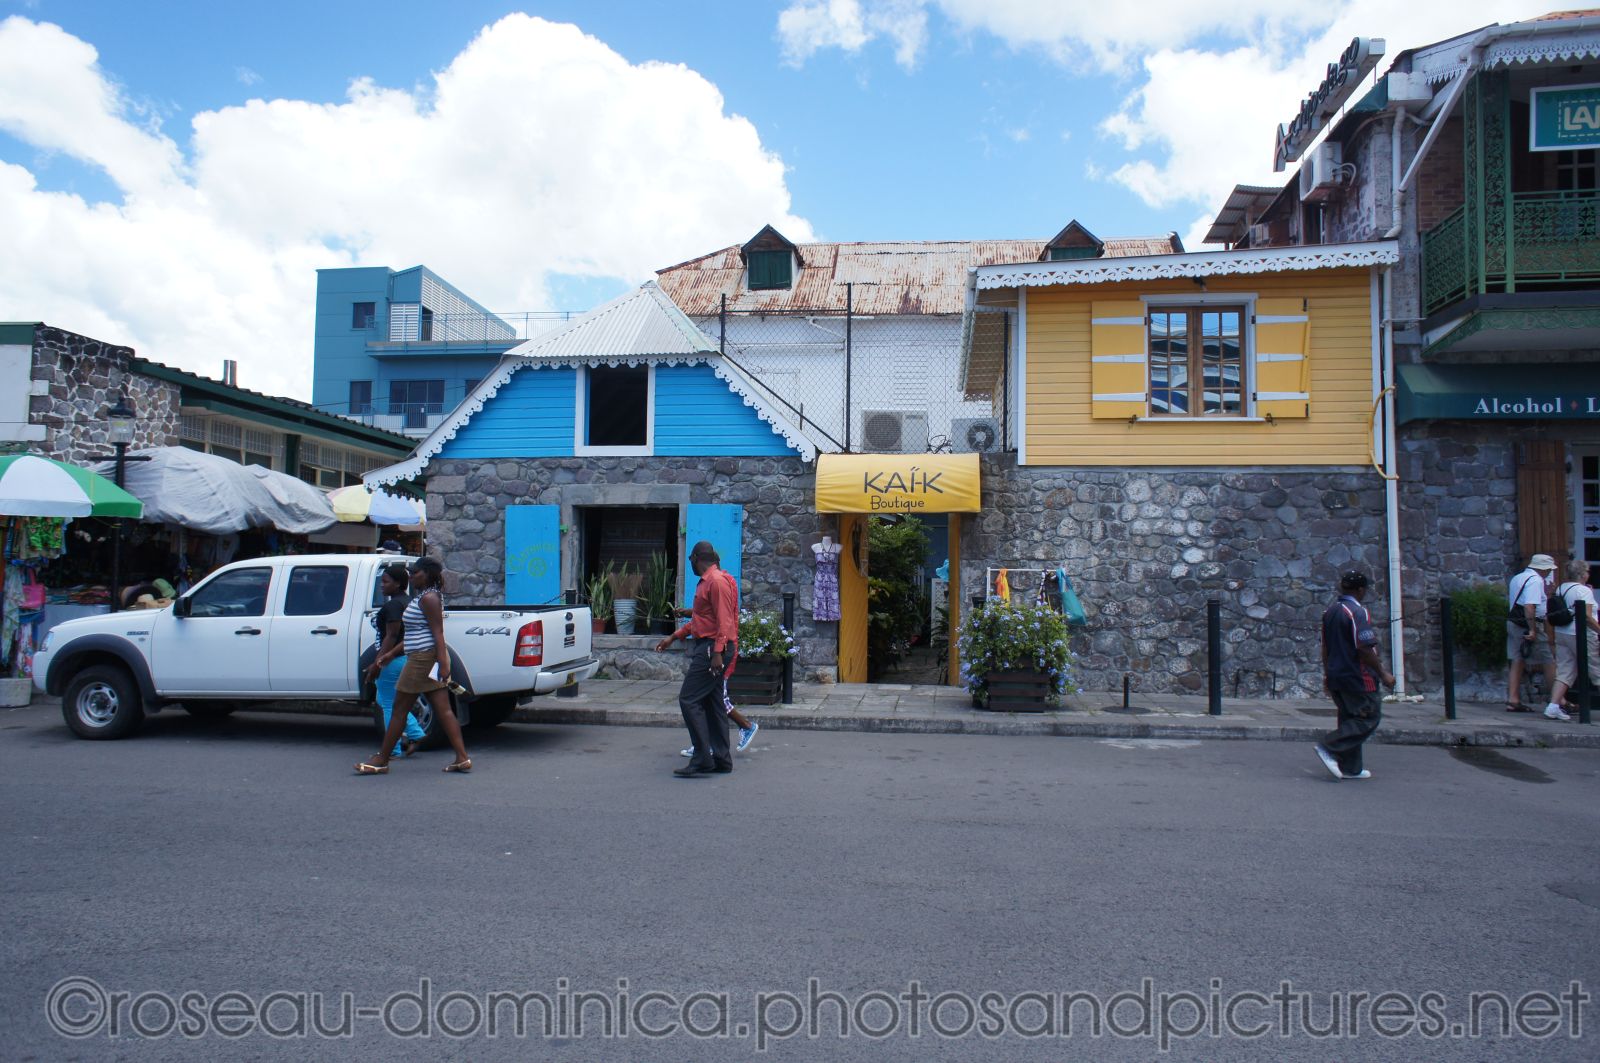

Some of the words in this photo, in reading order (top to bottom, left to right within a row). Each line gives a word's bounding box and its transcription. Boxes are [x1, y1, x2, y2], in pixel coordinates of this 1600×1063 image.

[1473, 397, 1563, 414] Alcohol
[870, 495, 925, 512] Boutique
[465, 626, 511, 637] 4x4
